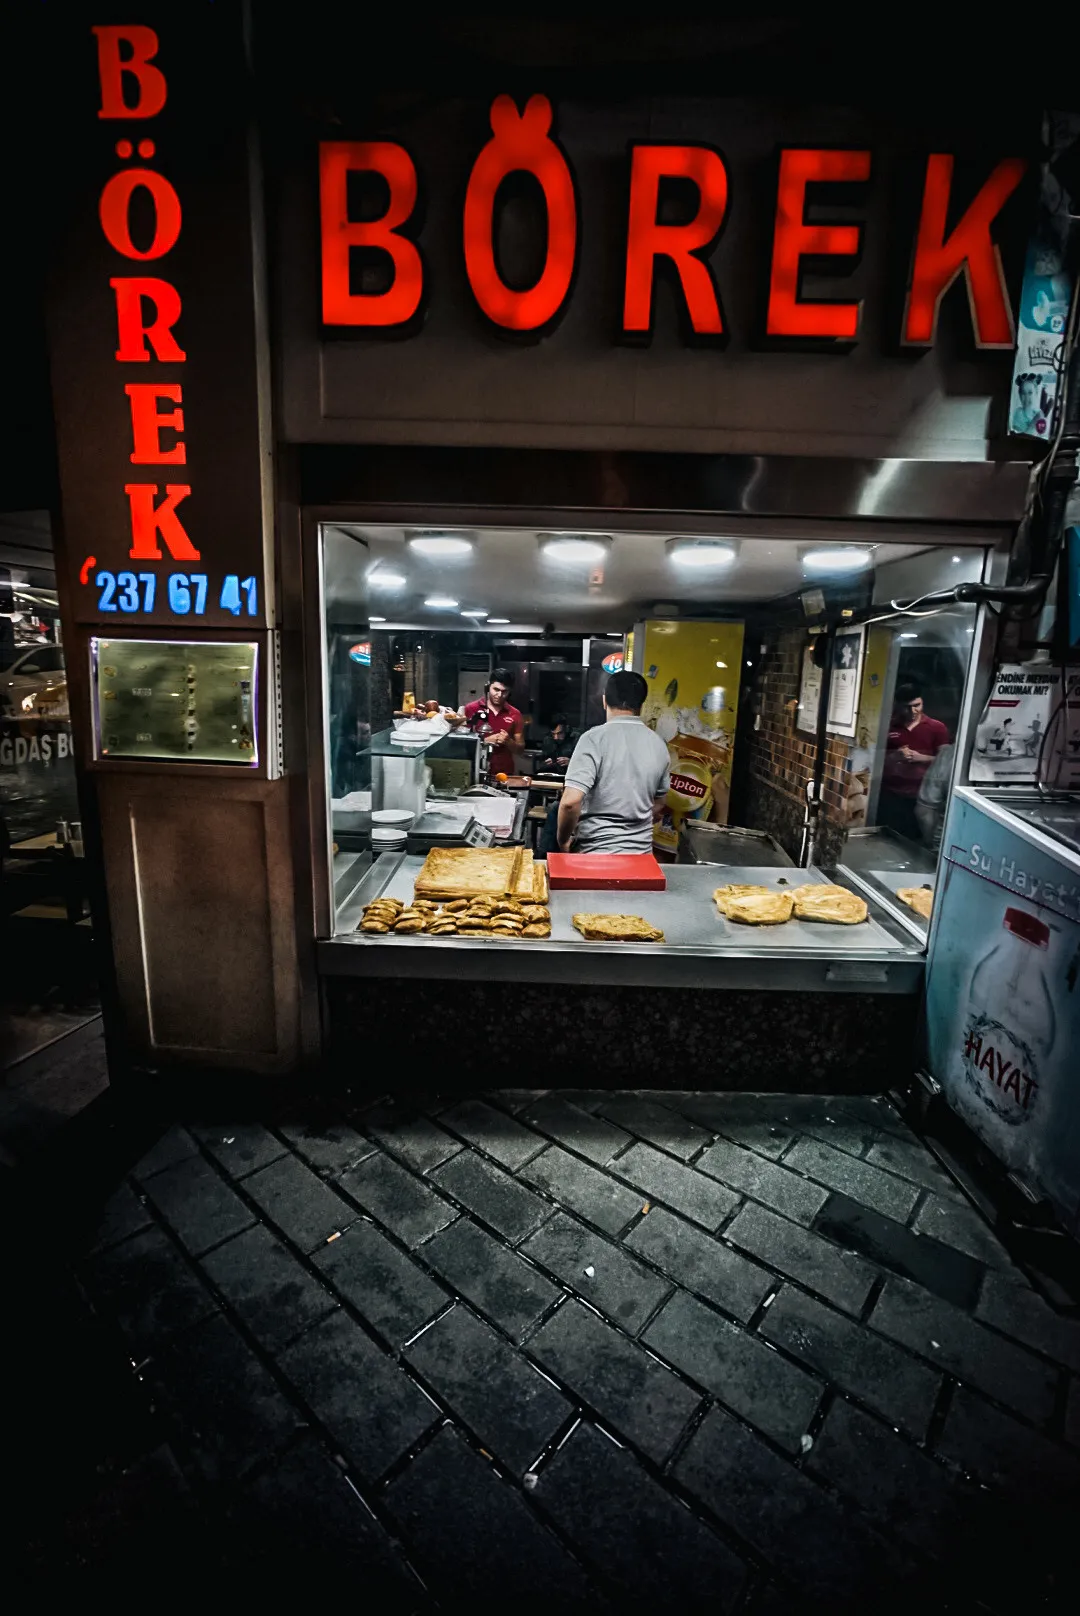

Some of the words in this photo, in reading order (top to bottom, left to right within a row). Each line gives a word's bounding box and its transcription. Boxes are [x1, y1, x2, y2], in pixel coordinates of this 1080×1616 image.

[319, 93, 1028, 346] BÖREK
[91, 24, 201, 561] BÖREK
[96, 571, 157, 613] 237
[167, 572, 208, 615] 67
[219, 575, 258, 616] 41
[998, 685, 1032, 695] OKUMAK
[669, 775, 704, 795] Lipton
[969, 844, 992, 872] Su
[1000, 857, 1080, 912] Hayat'
[964, 1031, 1039, 1110] HAYAT
